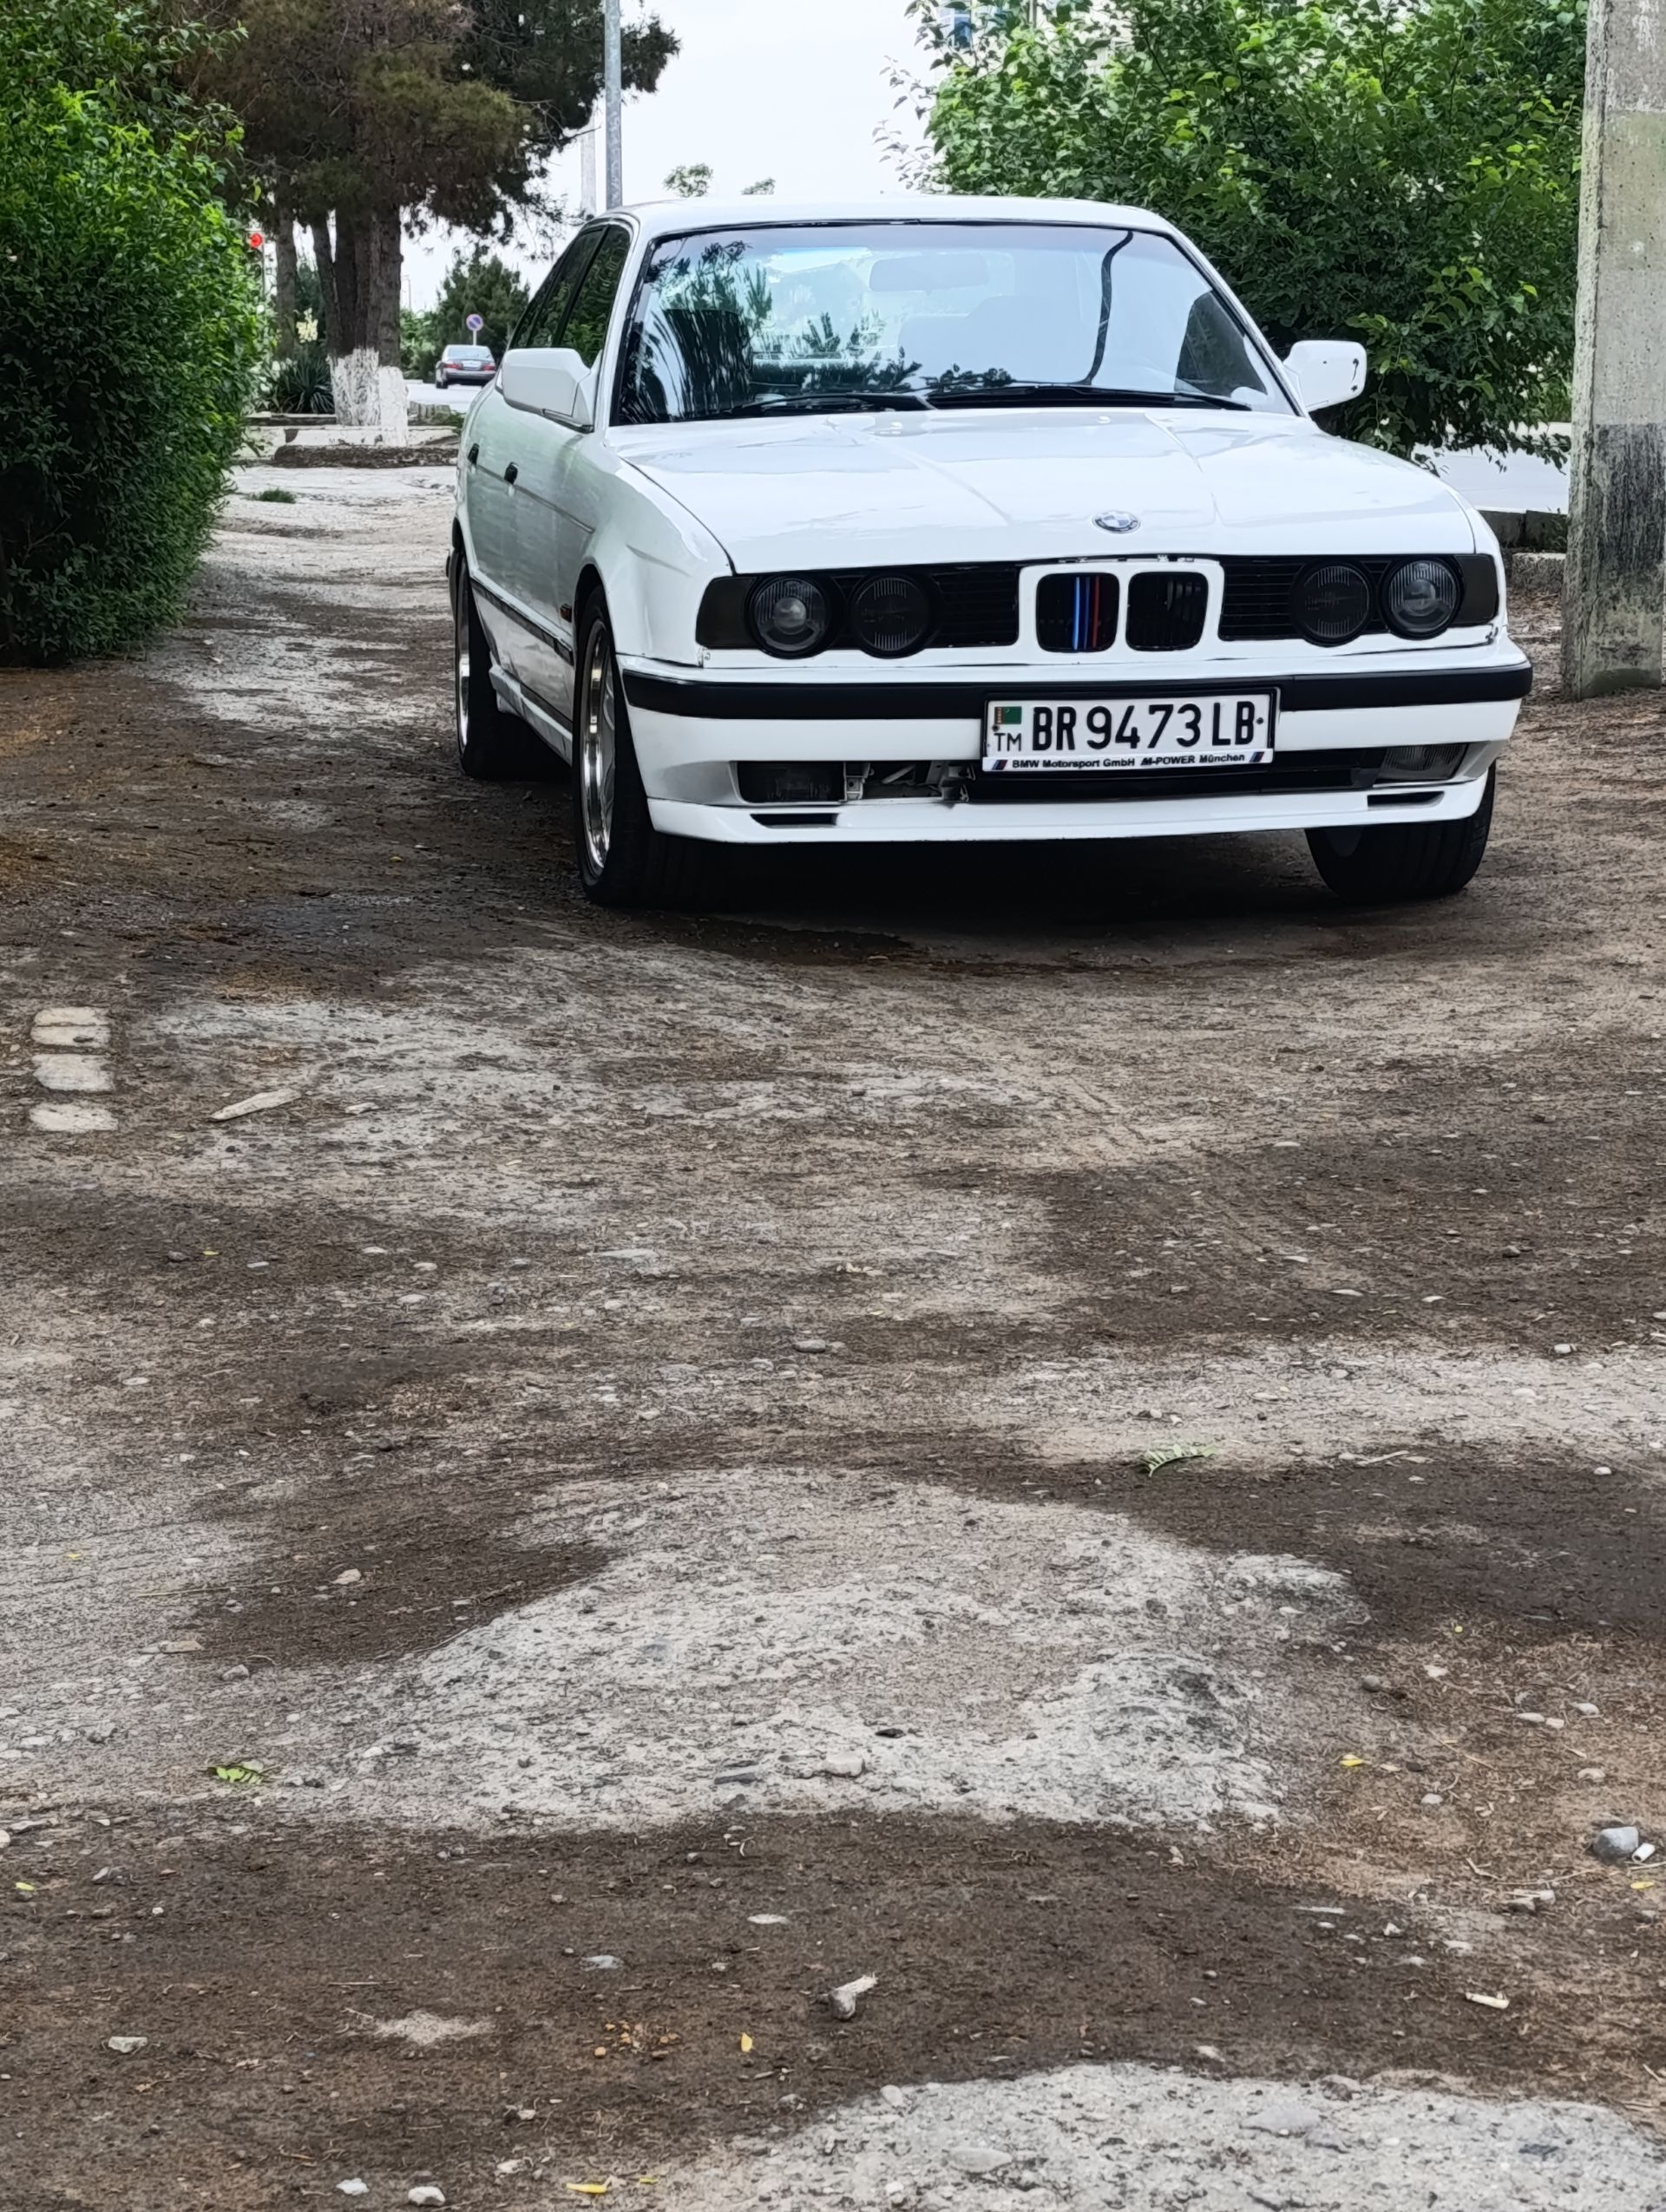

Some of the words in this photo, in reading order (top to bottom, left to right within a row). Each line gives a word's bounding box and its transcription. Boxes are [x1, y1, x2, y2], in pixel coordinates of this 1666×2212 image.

[1032, 705, 1077, 750] BR
[1086, 704, 1202, 750] 9473
[1211, 701, 1256, 747] LB
[994, 732, 1022, 751] TM
[1012, 759, 1040, 769] BMW
[1042, 758, 1100, 770] Motorsport
[1103, 757, 1135, 768] GmbH
[1199, 753, 1244, 763] München
